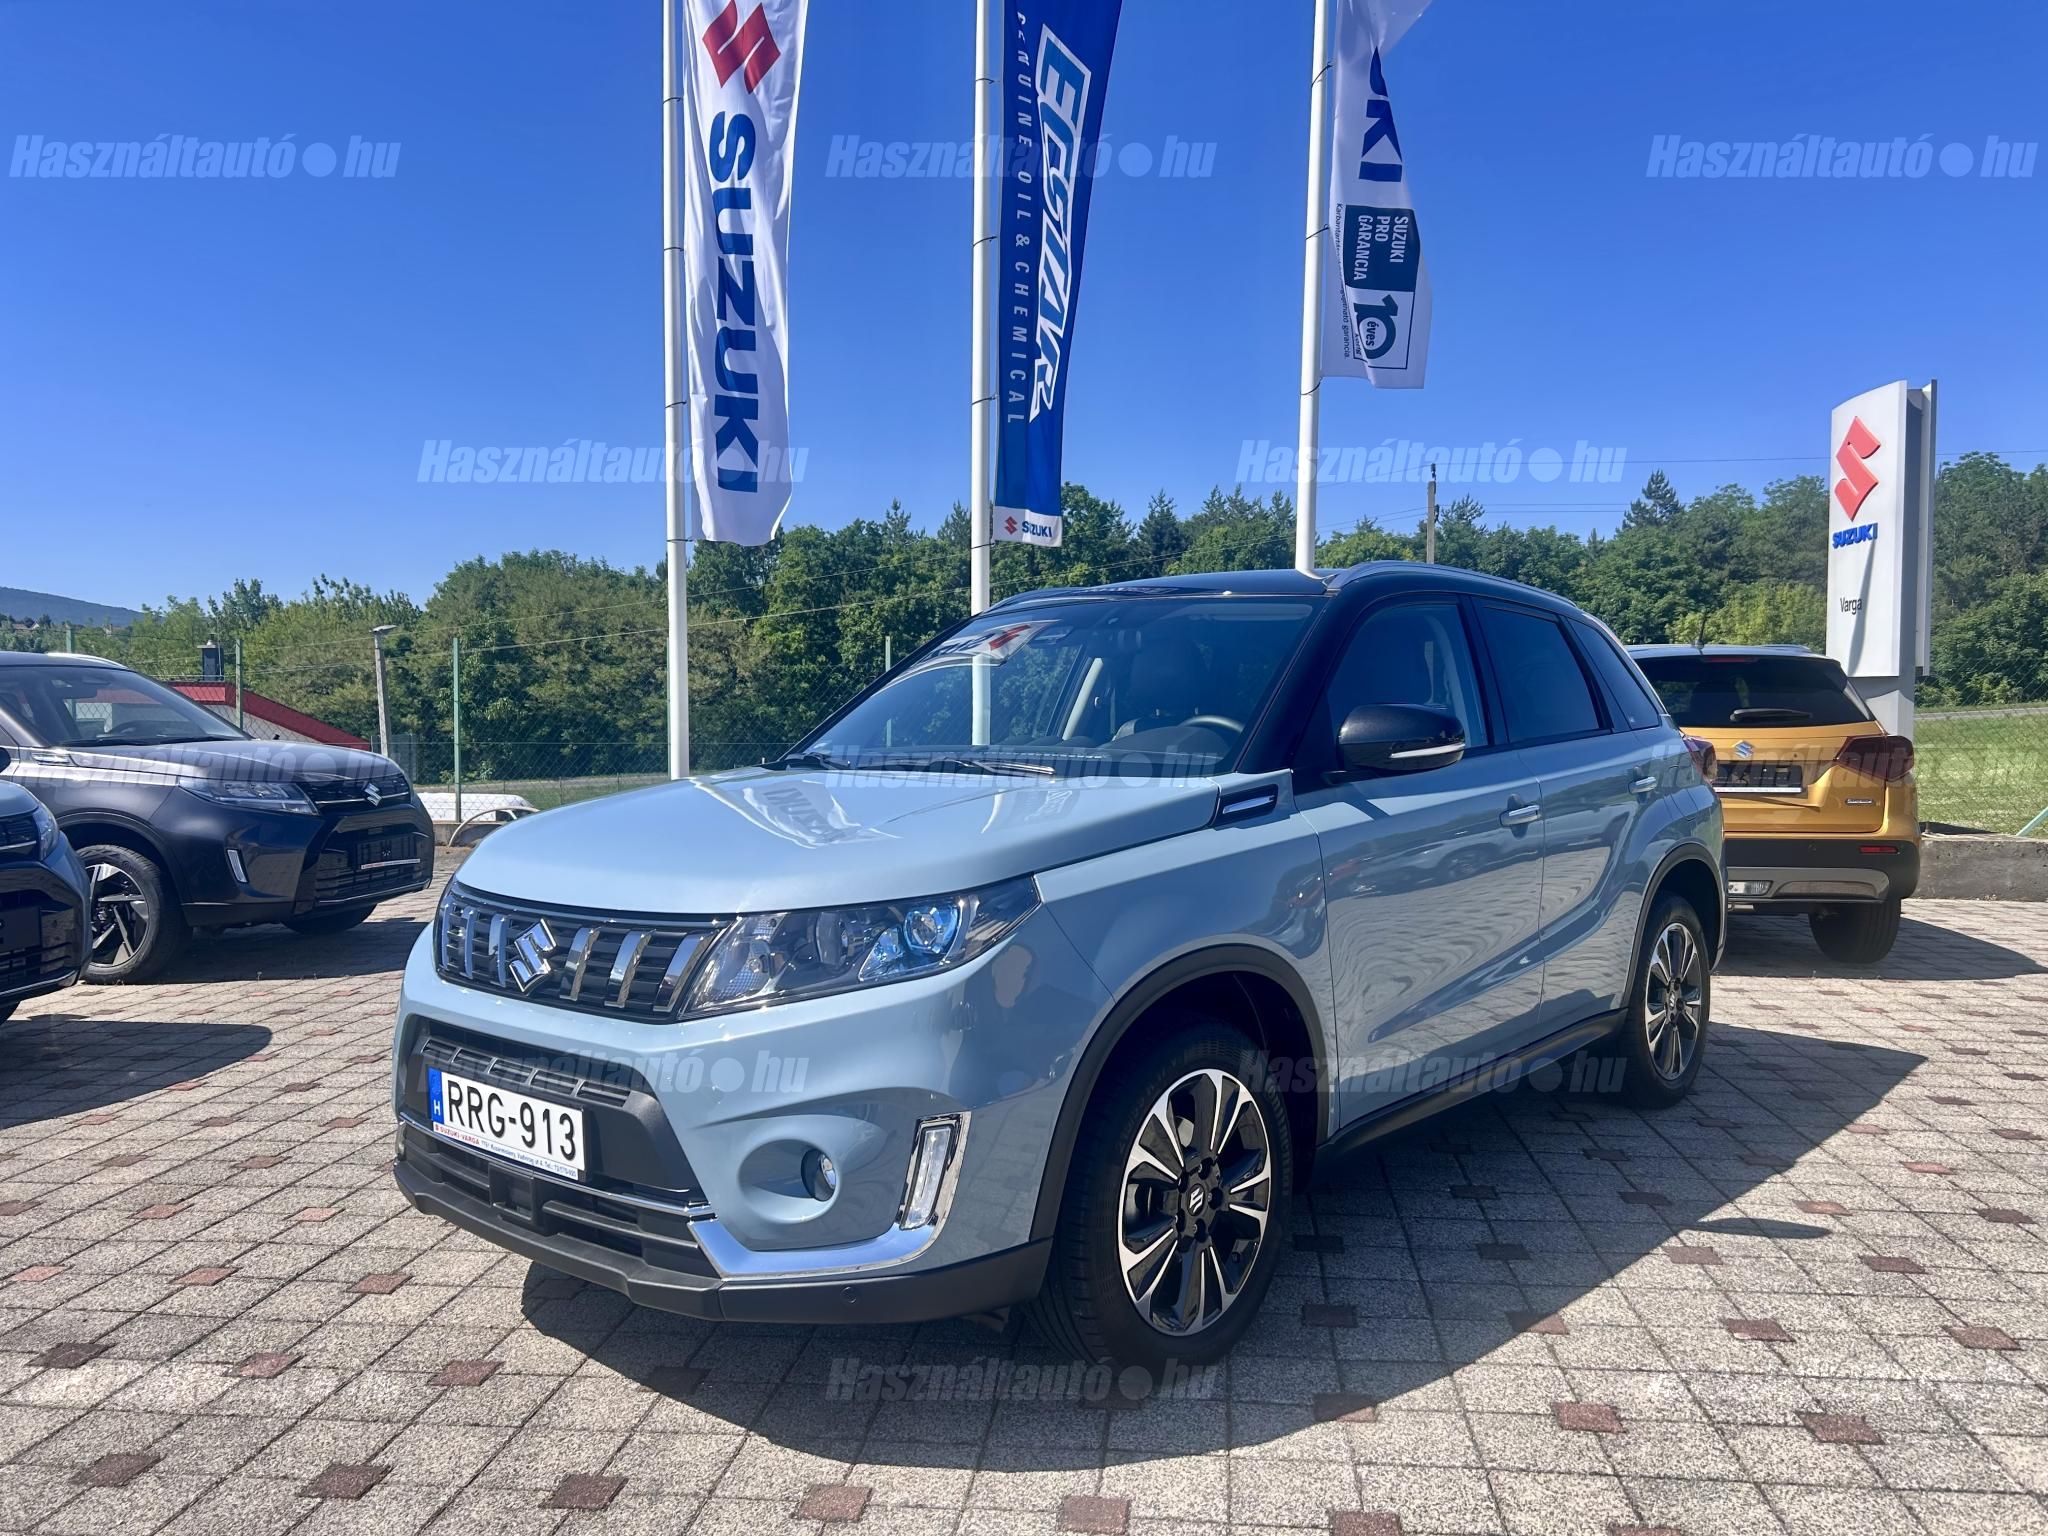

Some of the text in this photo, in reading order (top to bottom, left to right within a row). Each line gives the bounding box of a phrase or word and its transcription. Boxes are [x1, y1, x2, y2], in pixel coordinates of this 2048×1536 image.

[1016, 170, 1032, 219] OIL
[1015, 233, 1030, 248] &
[1029, 23, 1091, 422] ECSTAR
[1375, 215, 1391, 242] PRO
[1390, 216, 1408, 263] SUZUKI
[1353, 214, 1373, 281] GARANCIA
[709, 111, 758, 493] SUZUKI
[1007, 262, 1030, 424] CHEMICAL
[1366, 320, 1380, 347] éves
[1832, 522, 1878, 549] SUZUKI
[1840, 597, 1863, 615] Varga
[433, 1099, 441, 1116] H
[447, 1080, 576, 1161] RRG-913
